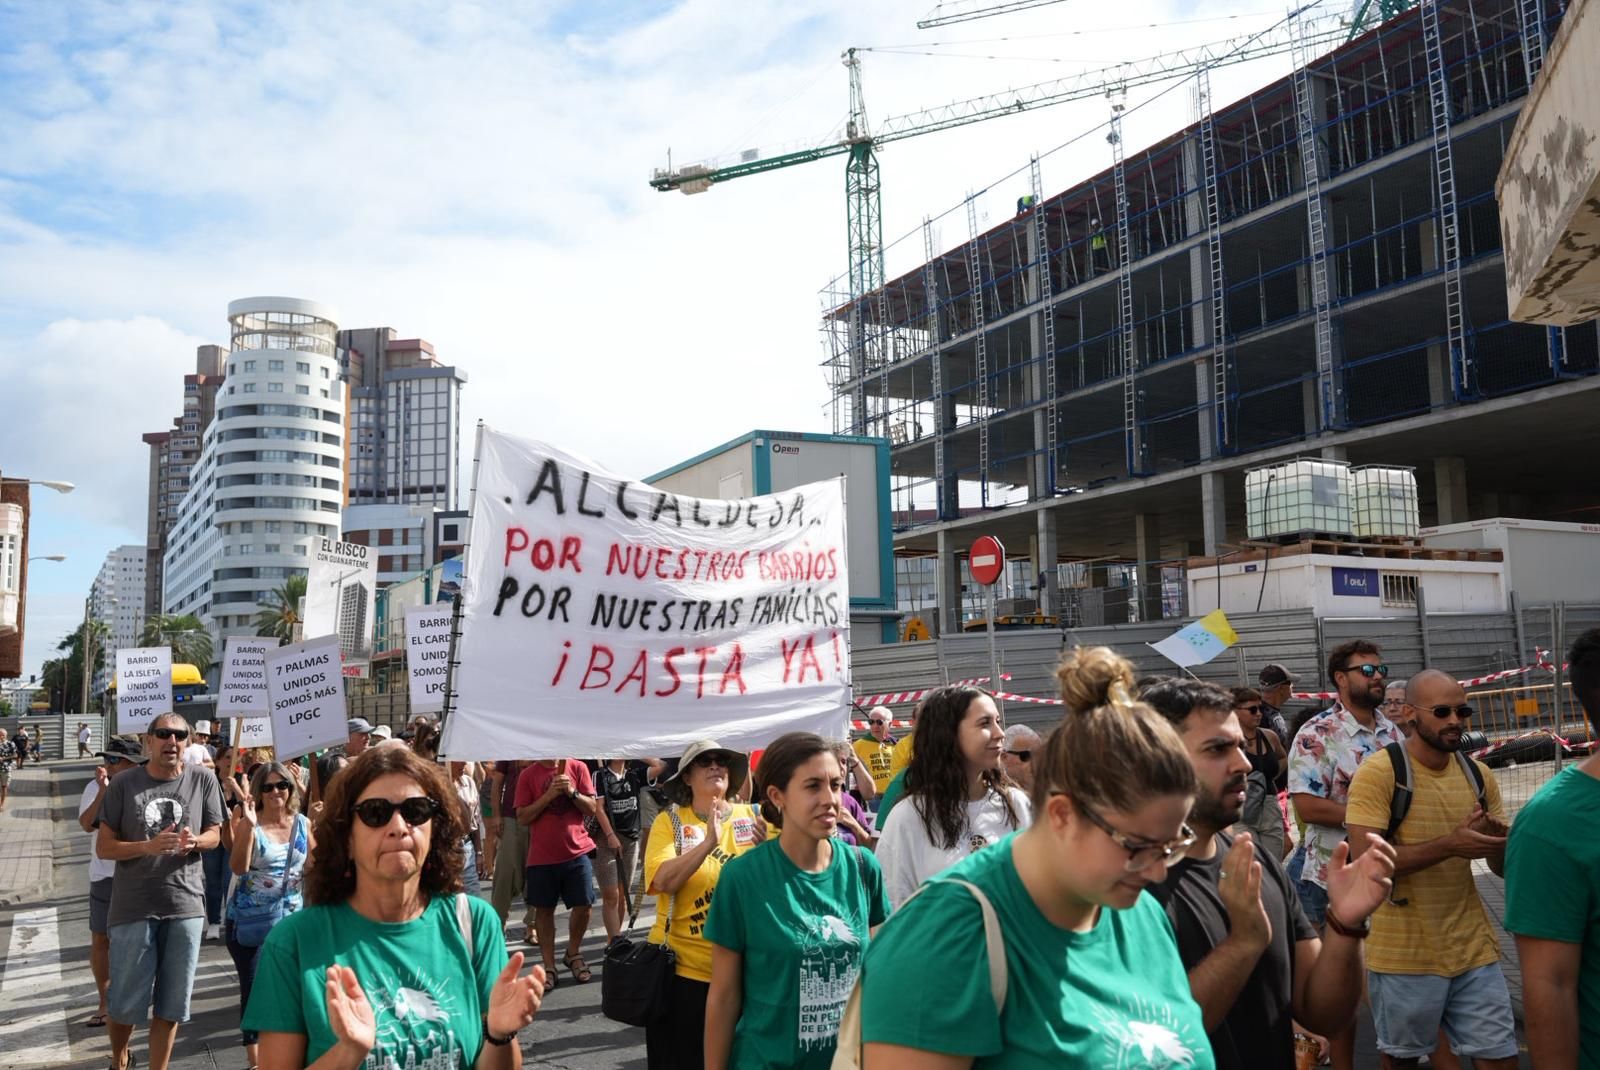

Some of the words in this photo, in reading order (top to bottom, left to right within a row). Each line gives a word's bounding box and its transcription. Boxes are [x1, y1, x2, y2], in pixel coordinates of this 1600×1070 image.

[772, 444, 799, 454] Opein
[322, 539, 332, 552] EL
[335, 541, 366, 559] RISCO
[505, 528, 581, 572] POR
[606, 544, 749, 581] NUESTROS
[758, 542, 837, 581] BARRIOS
[317, 553, 328, 561] CON
[329, 555, 369, 569] GUANARTEME
[493, 576, 571, 622] POR
[591, 593, 743, 631] NUESTRAS
[750, 587, 838, 626] FAMILIAS
[412, 636, 422, 645] EL
[425, 634, 451, 644] CARD
[127, 656, 158, 665] BARRIO
[421, 650, 447, 661] UNID
[276, 666, 282, 676] 7
[285, 654, 329, 673] PALMAS
[552, 641, 746, 699] ¡BASTA
[781, 631, 841, 683] YA!
[124, 670, 134, 678] LA
[136, 669, 161, 677] ISLETA
[232, 671, 263, 679] UNIDOS
[127, 682, 159, 690] UNIDOS
[283, 672, 326, 691] UNIDOS
[426, 683, 446, 694] LPG
[120, 695, 148, 704] SOMOS
[149, 693, 166, 701] MÁS
[230, 695, 253, 703] LPGC
[275, 692, 312, 710] SOMOS
[314, 685, 337, 699] MÁS
[129, 707, 153, 717] LPGC
[289, 707, 321, 725] LPGC
[242, 724, 263, 733] LPGC
[801, 1014, 817, 1023] EN
[801, 1024, 814, 1033] DE
